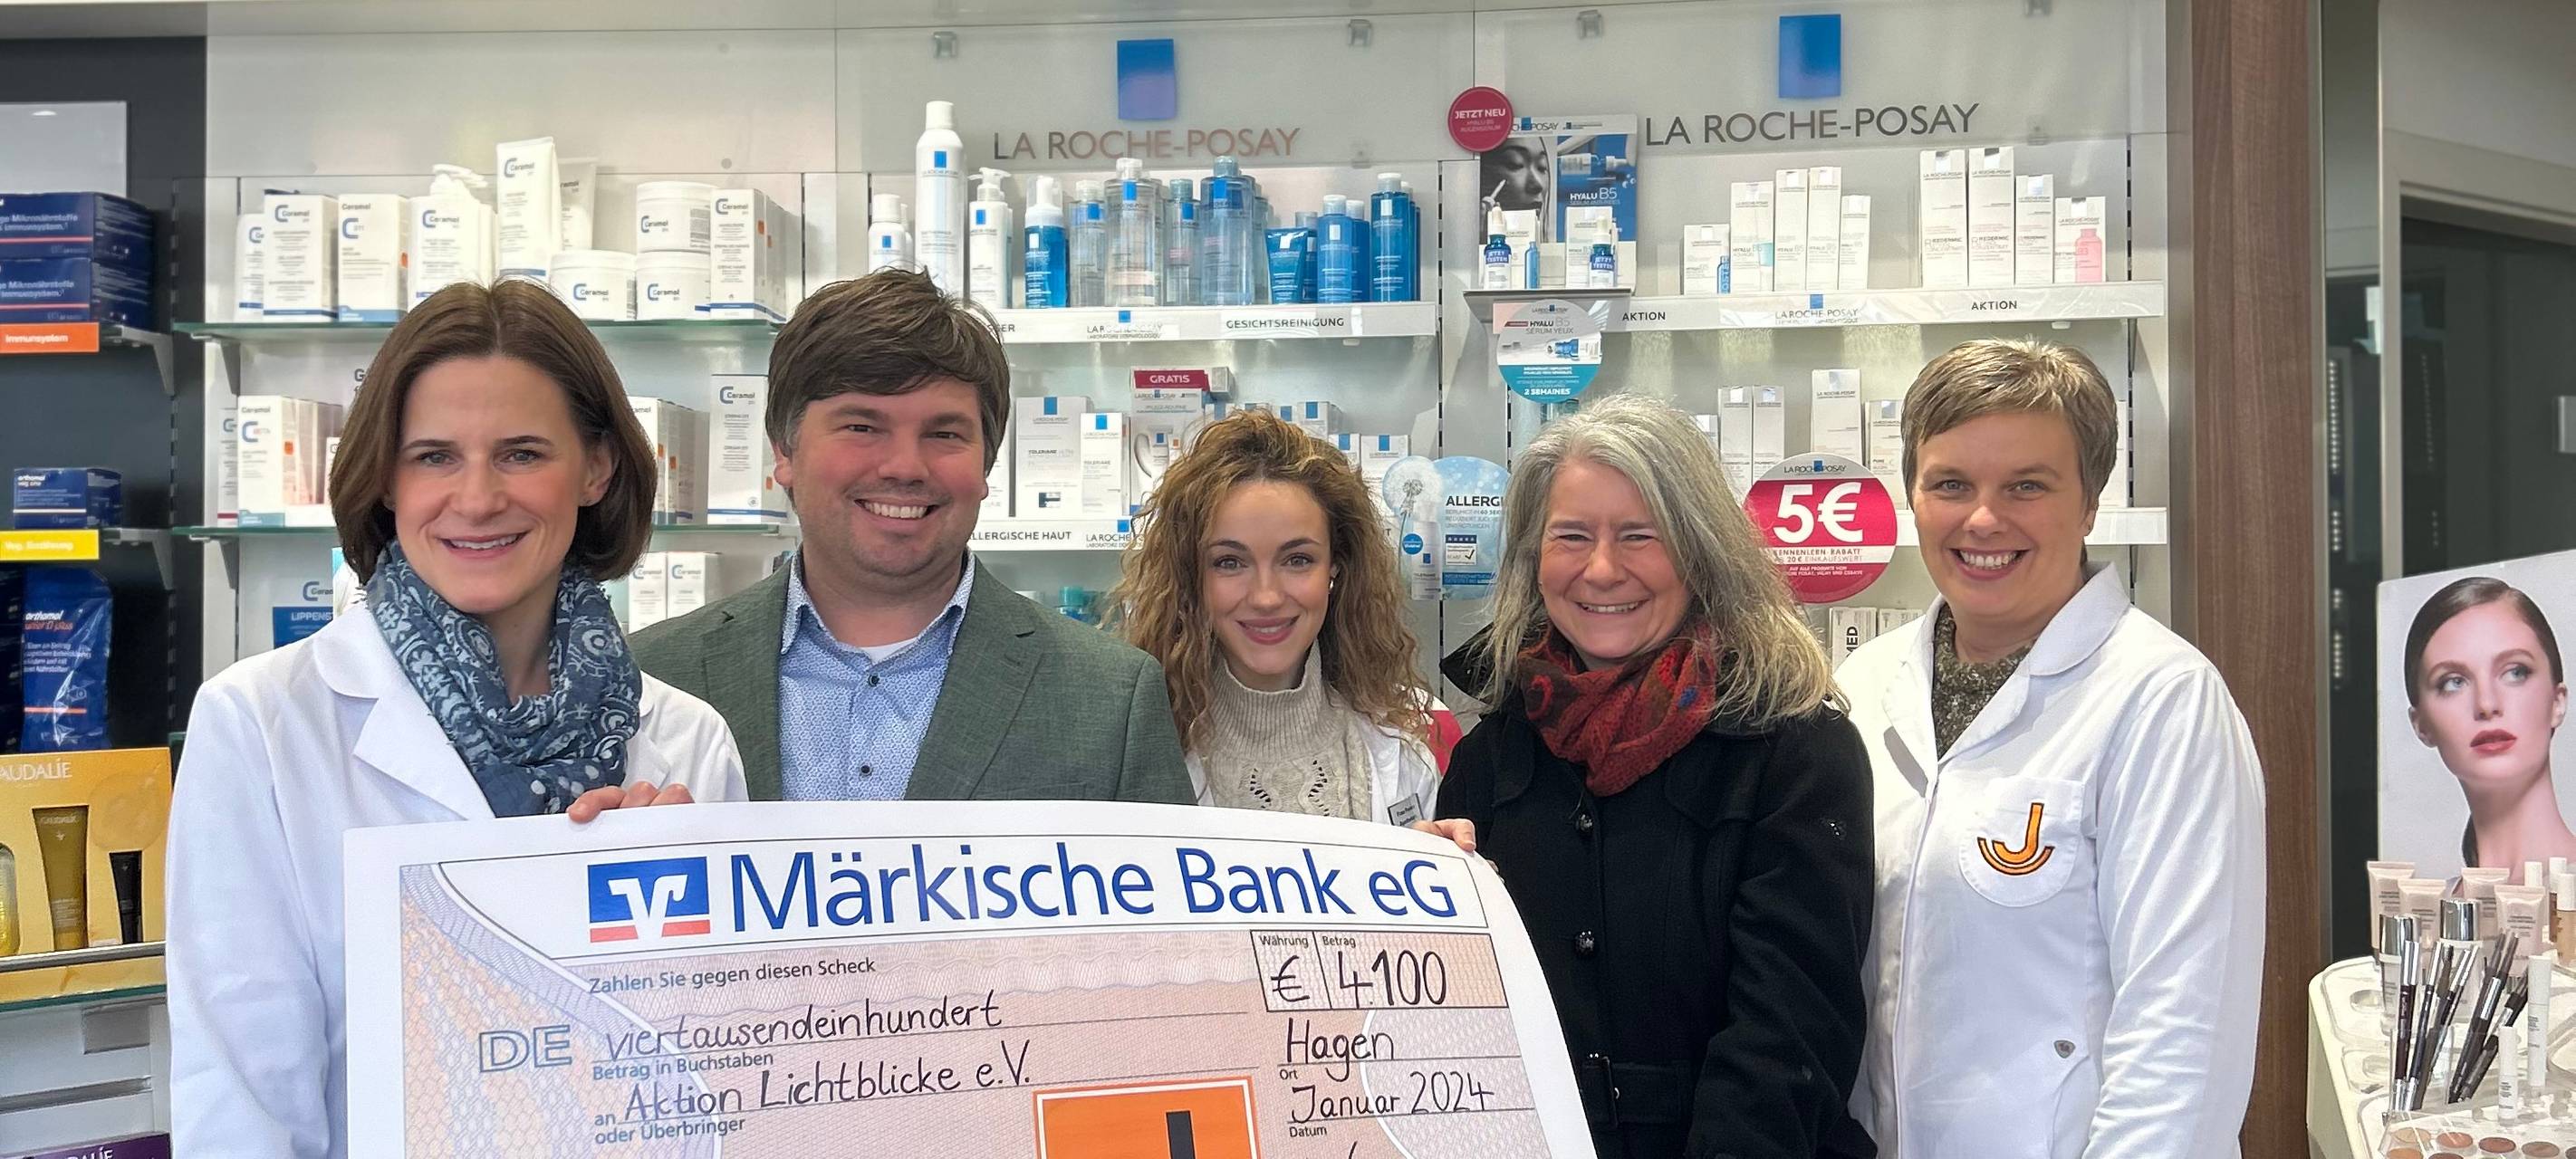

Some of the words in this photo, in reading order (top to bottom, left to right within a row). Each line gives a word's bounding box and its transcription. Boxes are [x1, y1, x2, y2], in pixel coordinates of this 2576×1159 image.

[1455, 110, 1483, 120] JETZT
[1485, 108, 1506, 118] NEU
[1646, 116, 1692, 146] LA
[1704, 102, 1980, 143] ROCHE-POSAY
[994, 131, 1036, 161] LA
[1049, 127, 1301, 161] ROCHE-POSAY
[510, 162, 535, 171] Ceramol
[1570, 192, 1598, 201] HYALU
[1599, 187, 1618, 200] B5
[428, 216, 460, 224] Ceramol
[1971, 300, 2018, 311] AKTION
[1226, 317, 1344, 330] GESICHTSREINIGUNG
[1621, 311, 1666, 322] AKTION
[5, 334, 69, 344] Immunsystem
[1149, 374, 1190, 384] GRATIS
[1043, 531, 1072, 541] HAUT
[1086, 533, 1098, 542] LA
[25, 609, 63, 621] orthomol
[0, 758, 73, 781] AUDALÍE
[731, 842, 1155, 932] Märkische
[1176, 848, 1356, 915] Bank
[1369, 860, 1458, 918] eG
[1259, 934, 1309, 949] Währung
[1322, 935, 1357, 949] Betrag
[589, 974, 654, 994] Zahlen
[659, 971, 687, 989] Sie
[692, 967, 750, 990] gegen
[755, 963, 813, 982] diesen
[818, 957, 877, 976] Scheck
[1270, 954, 1311, 1003] €
[606, 989, 1003, 1063] viertausendeinhundert
[478, 1024, 573, 1074] DE
[1284, 1017, 1395, 1083] Hagen
[593, 1063, 650, 1081] Betrag
[656, 1059, 671, 1076] in
[677, 1052, 774, 1074] Buchstaben
[624, 1081, 743, 1123] Aktion
[760, 1056, 961, 1109] Lichtblicke
[976, 1039, 1032, 1088] e.V.
[1279, 1068, 1300, 1081] Ort
[1291, 1084, 1401, 1125] Januar
[1408, 1070, 1495, 1116] 2024
[594, 1114, 616, 1128] an
[594, 1129, 635, 1145] oder
[640, 1117, 746, 1141] Überbringer
[1289, 1125, 1328, 1138] Datum
